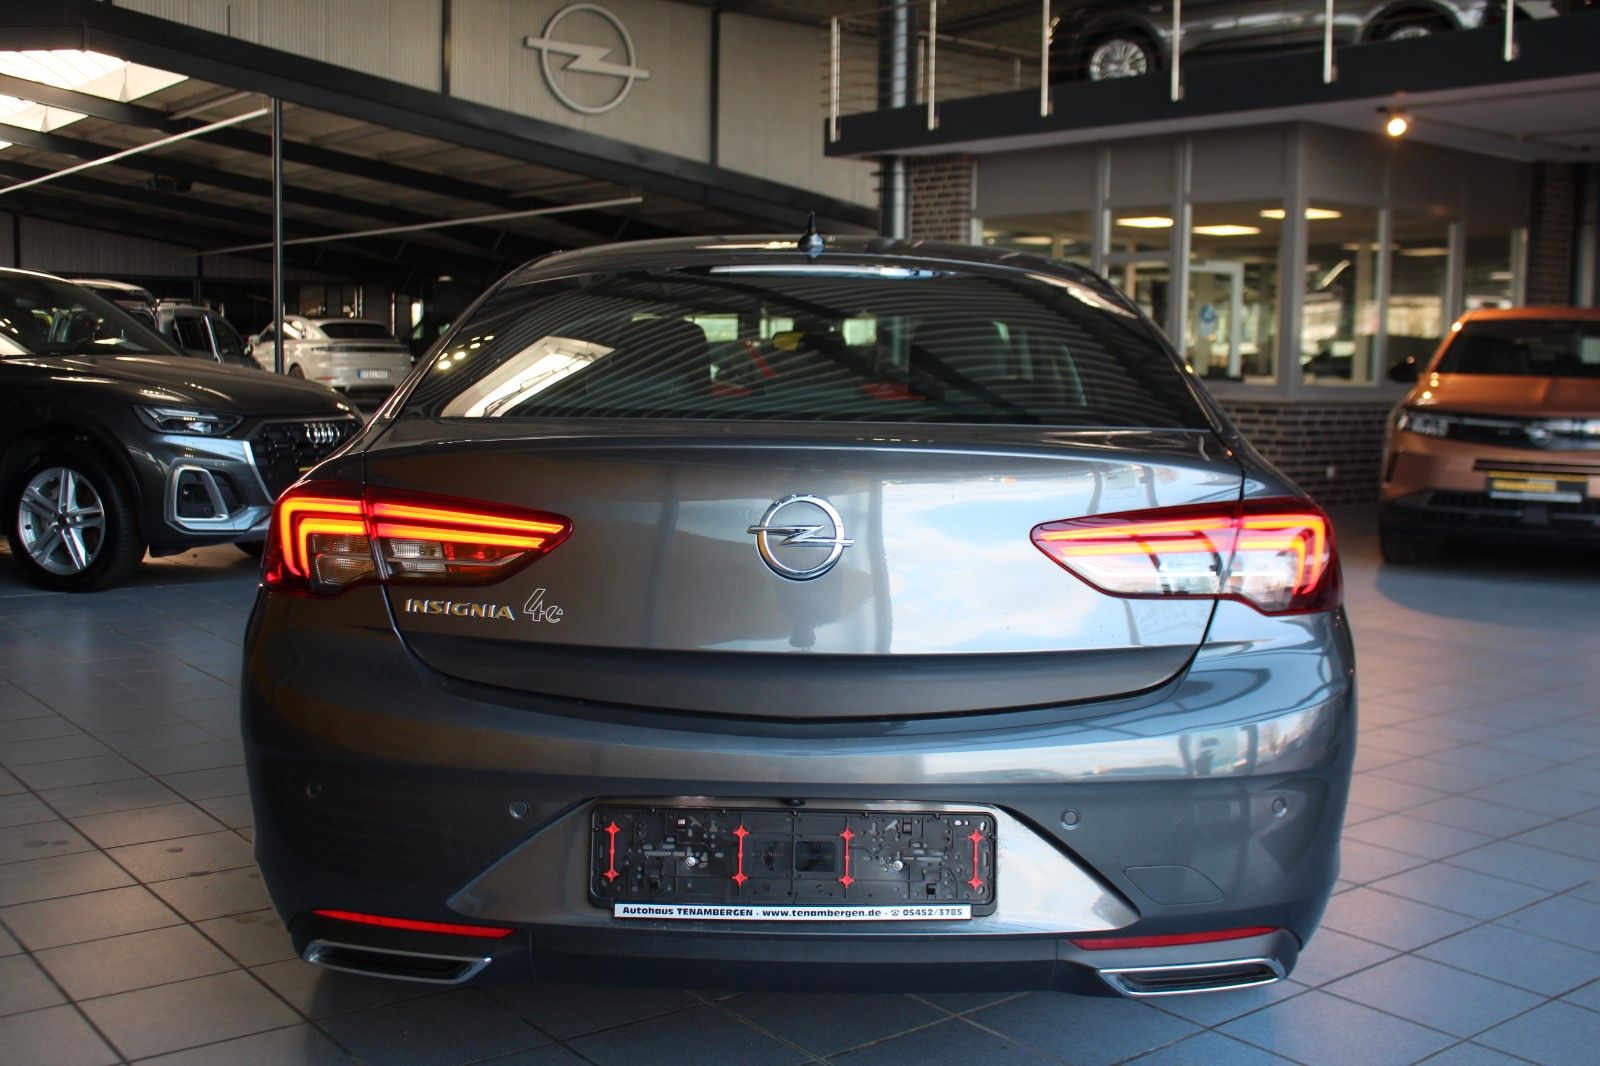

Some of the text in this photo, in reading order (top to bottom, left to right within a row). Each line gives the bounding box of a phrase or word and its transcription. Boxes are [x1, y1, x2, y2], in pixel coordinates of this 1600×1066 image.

[404, 598, 515, 621] INSIGNIA
[622, 906, 963, 918] Autohaus TENAMBERGEN www.tenambergen.de 05452/3785
